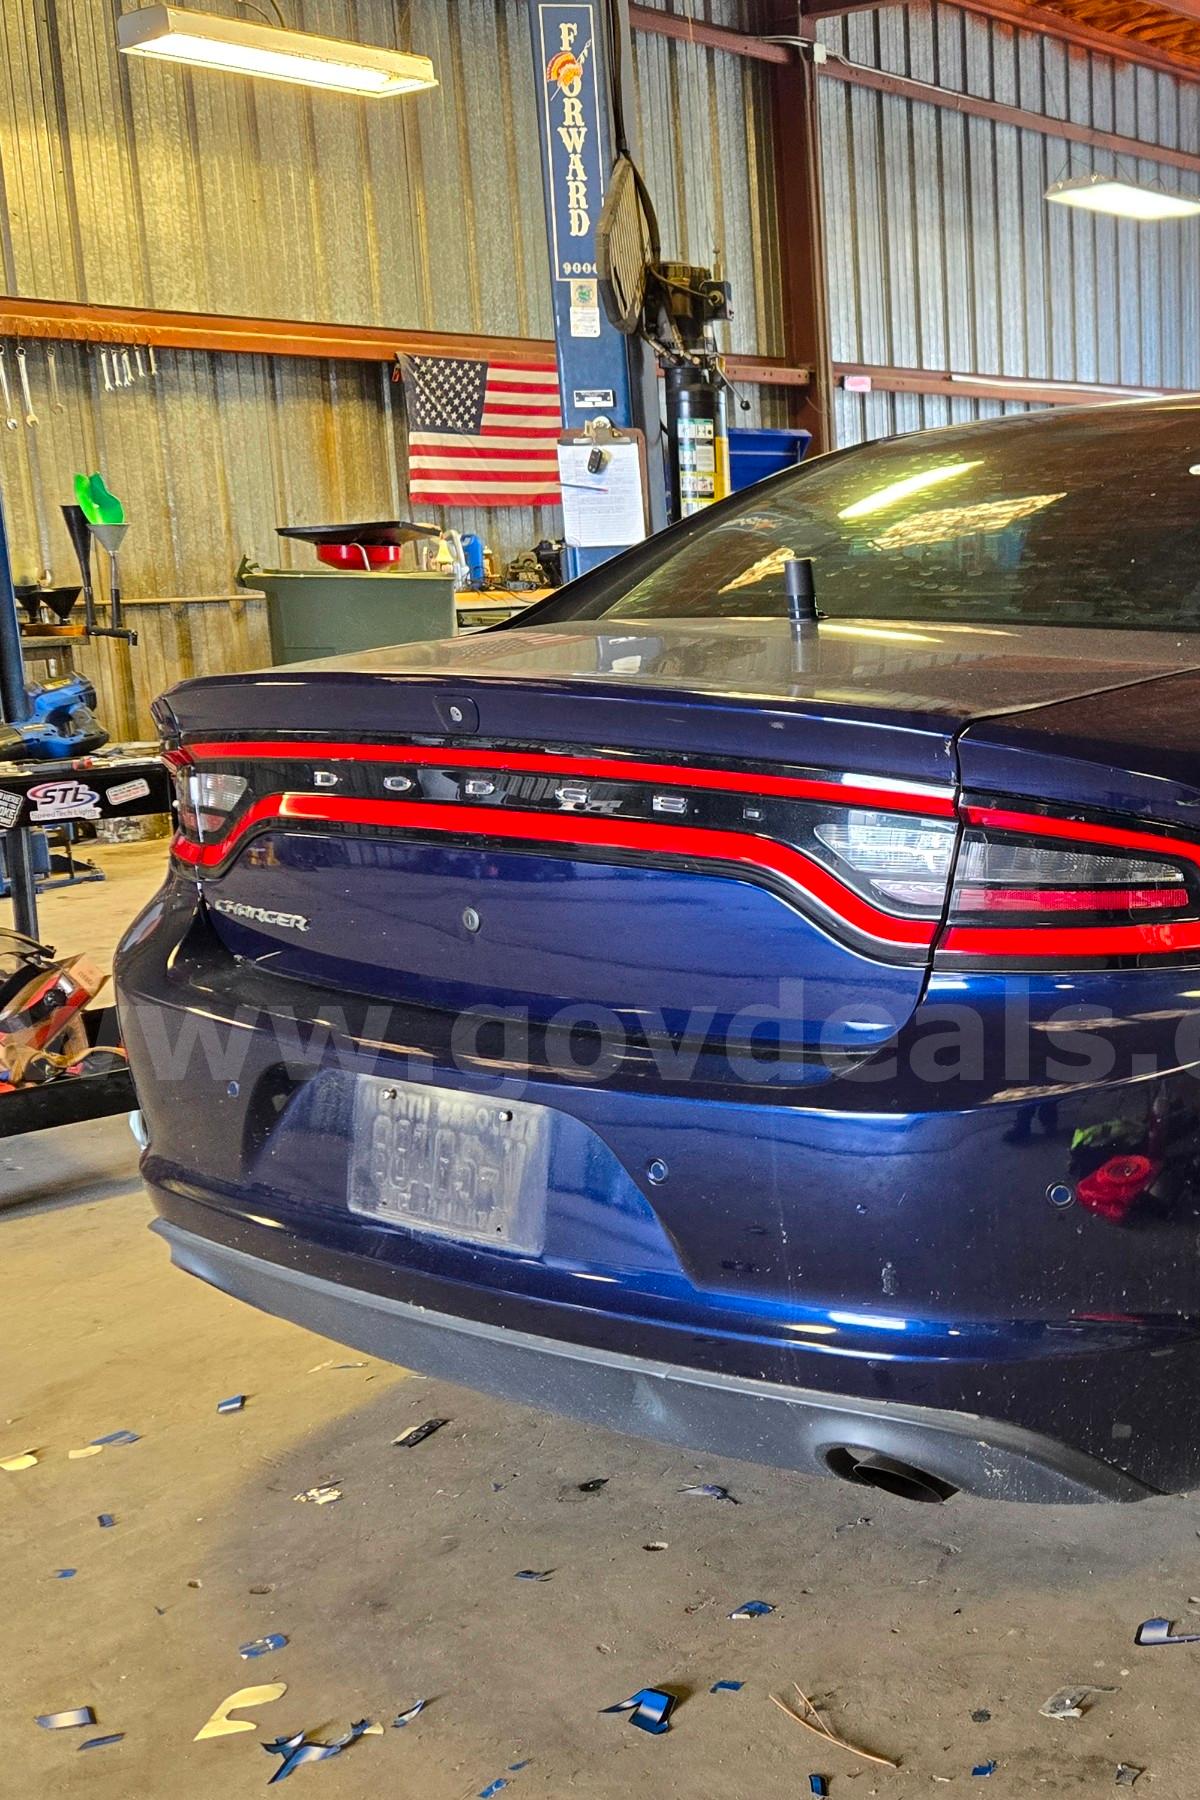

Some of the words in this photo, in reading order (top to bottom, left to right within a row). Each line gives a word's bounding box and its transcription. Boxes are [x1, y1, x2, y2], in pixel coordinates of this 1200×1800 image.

[557, 23, 590, 236] FORWARD
[40, 787, 84, 805] STL
[214, 900, 311, 932] CHARGER
